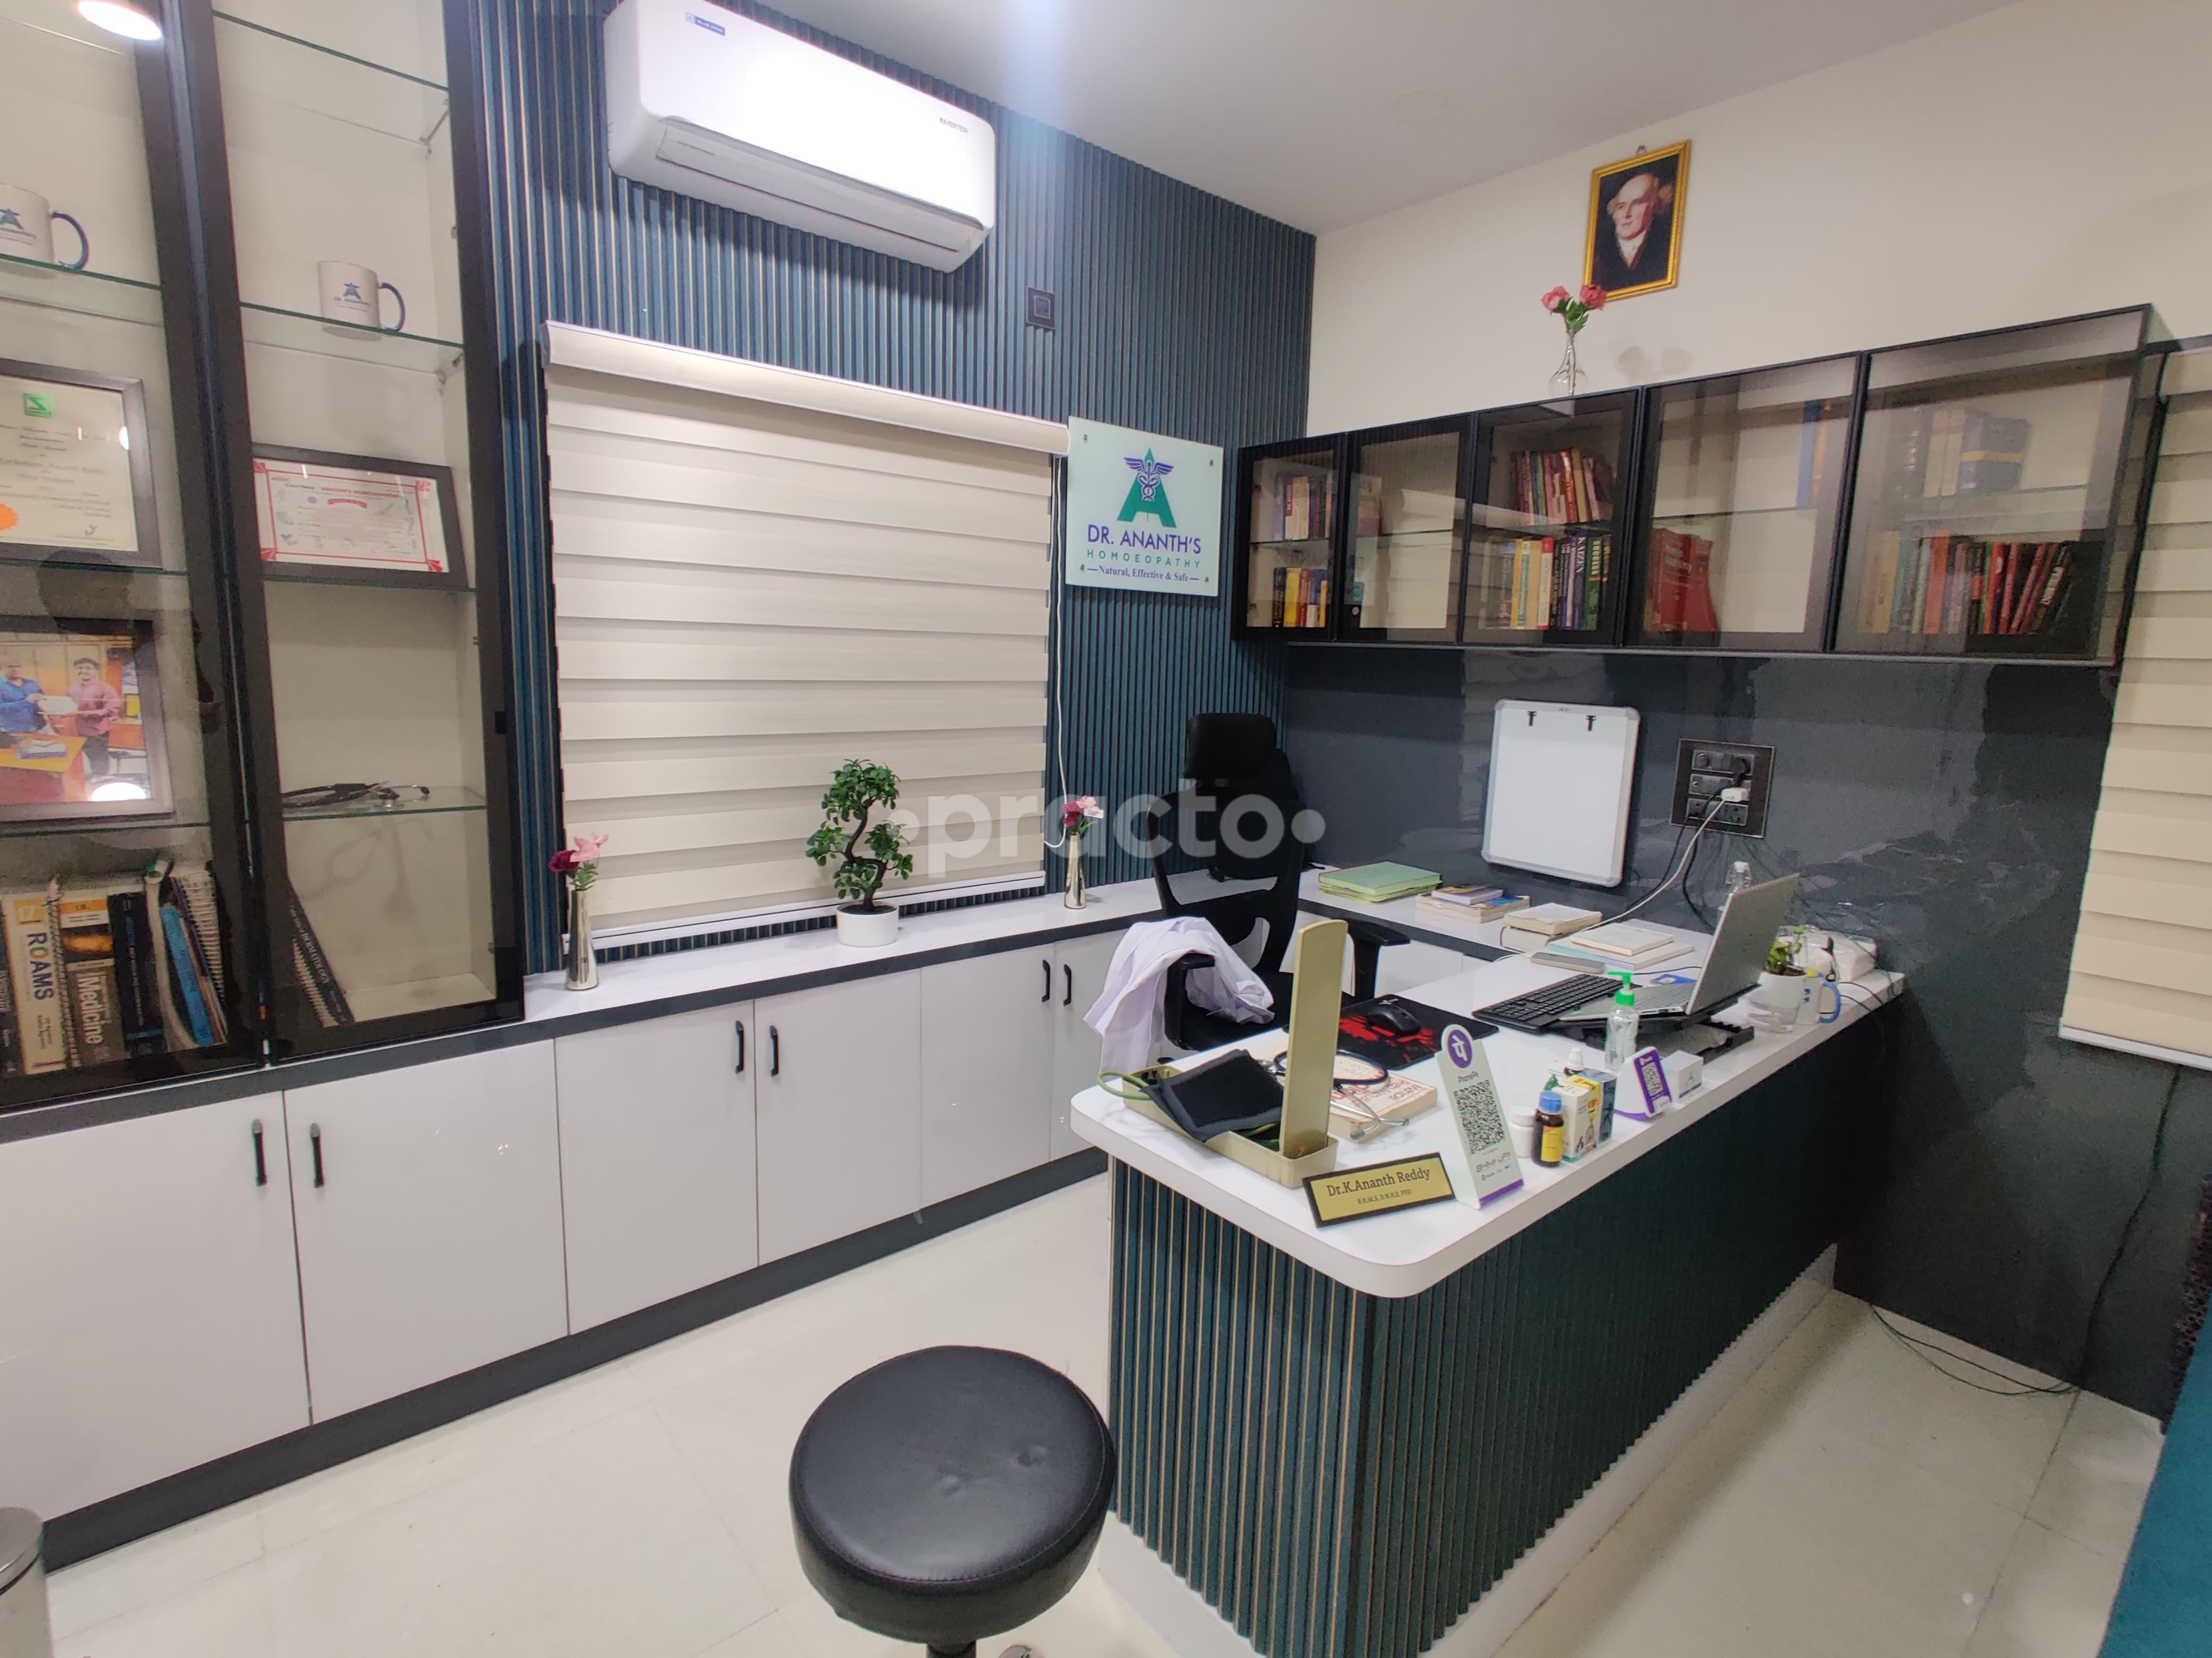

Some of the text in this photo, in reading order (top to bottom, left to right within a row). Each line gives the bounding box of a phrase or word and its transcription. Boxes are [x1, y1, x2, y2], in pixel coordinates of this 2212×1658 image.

[940, 116, 968, 133] INVERTER
[1087, 524, 1201, 554] DR. ANANTH'S
[1087, 549, 1201, 569] HOMOEOPATHY
[1132, 567, 1163, 580] Effective
[1165, 571, 1172, 580] &
[1174, 572, 1189, 582] Safe
[27, 932, 54, 1001] ROAMS
[301, 932, 330, 983] DERMATOLOGY
[77, 976, 103, 1045] Medicine
[1396, 1167, 1430, 1183] Reddy
